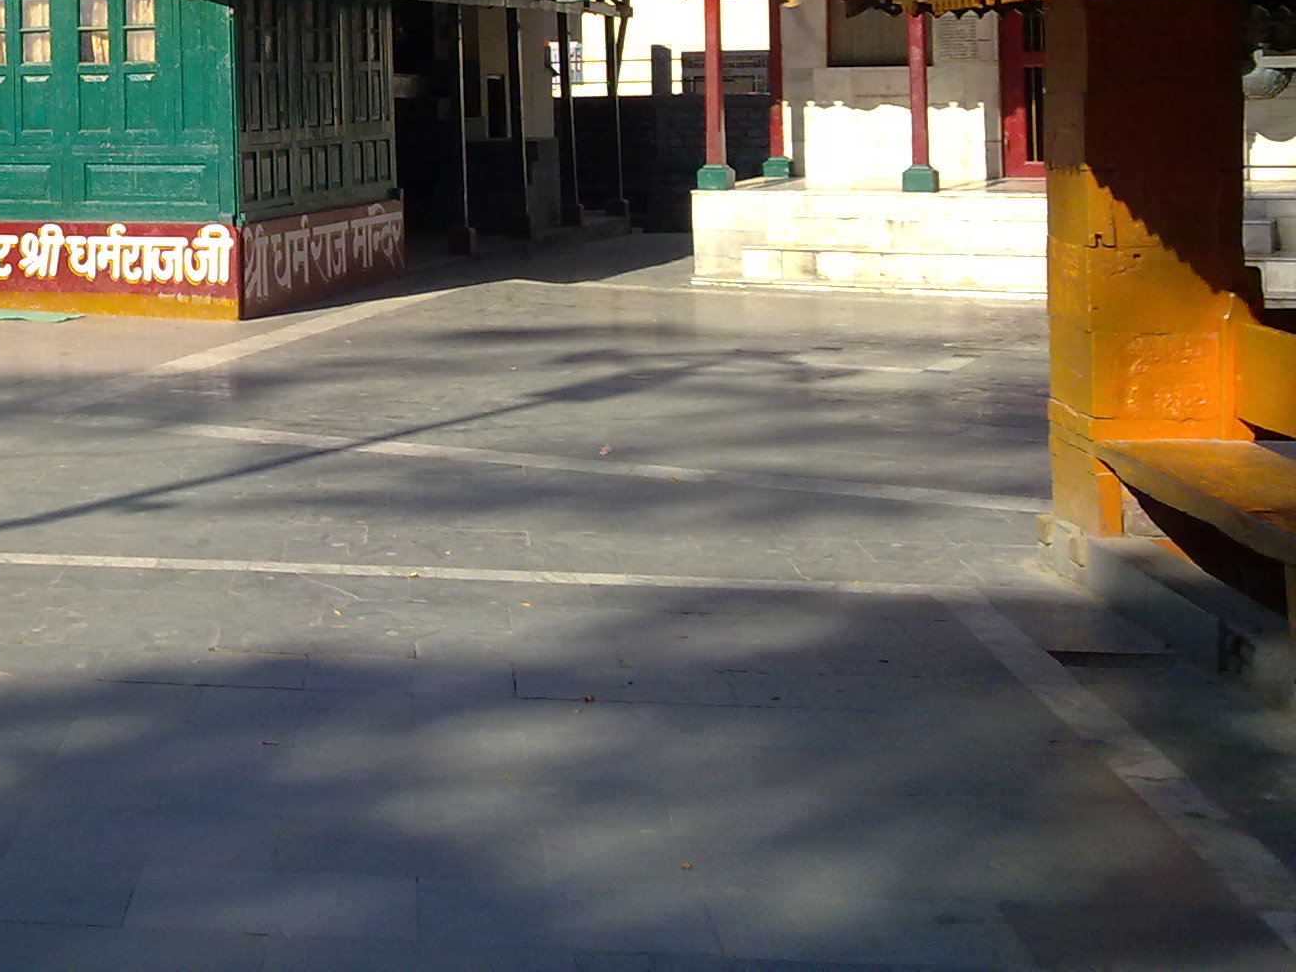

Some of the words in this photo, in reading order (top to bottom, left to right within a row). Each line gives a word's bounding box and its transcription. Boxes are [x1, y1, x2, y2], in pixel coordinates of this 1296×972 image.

[19, 223, 65, 279] श्री
[242, 223, 270, 301] श्री
[350, 202, 406, 268] मन्दिर
